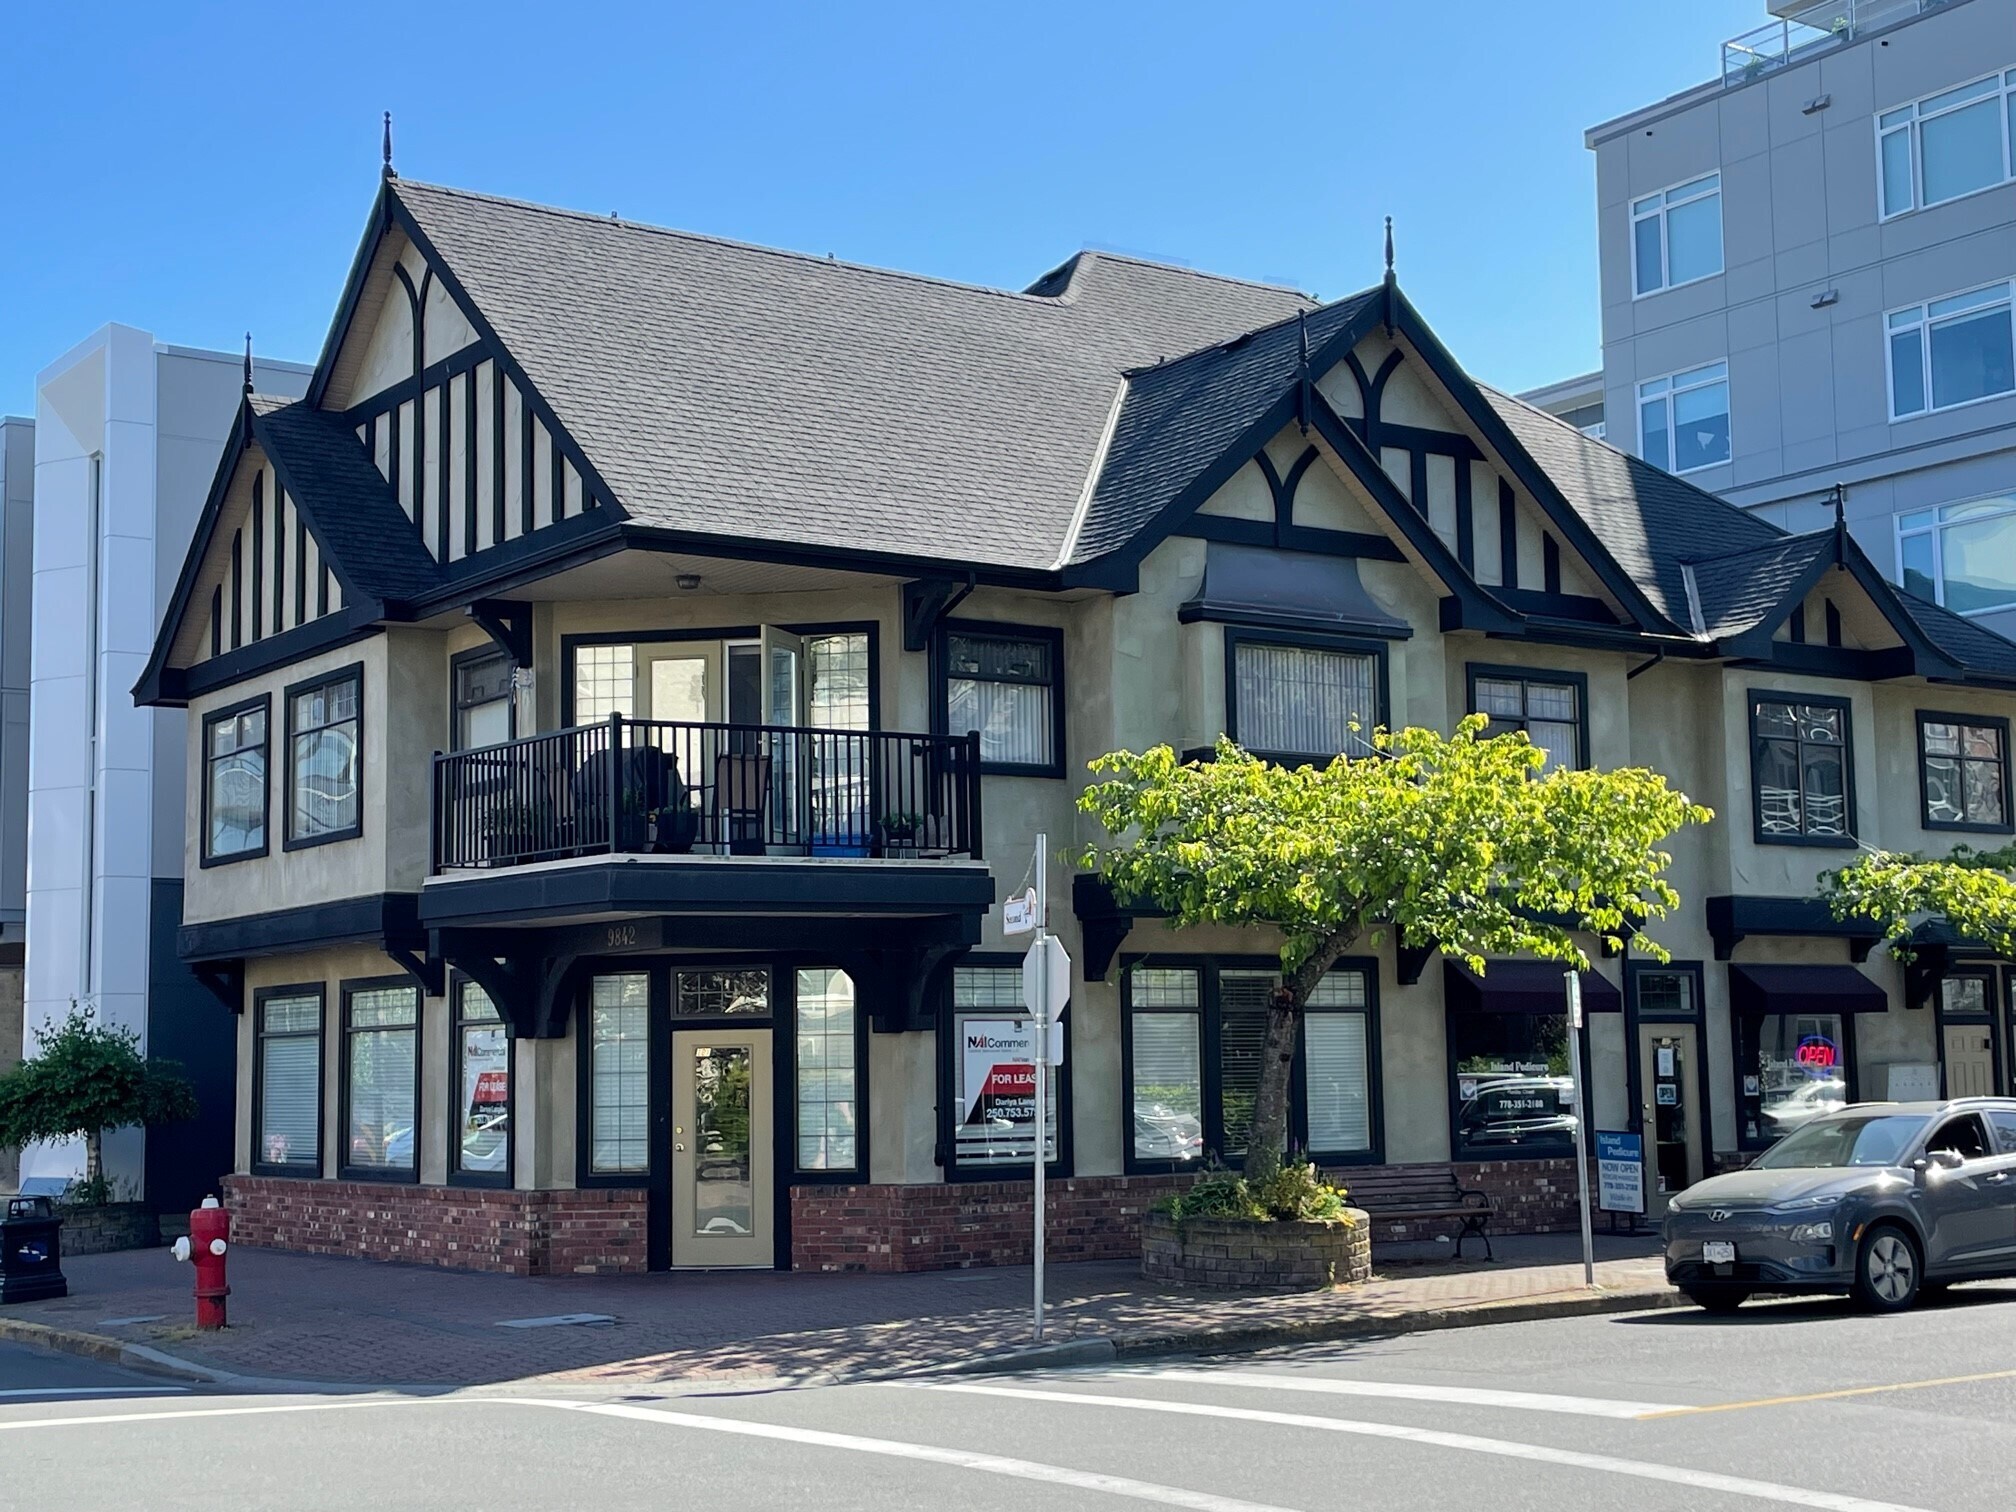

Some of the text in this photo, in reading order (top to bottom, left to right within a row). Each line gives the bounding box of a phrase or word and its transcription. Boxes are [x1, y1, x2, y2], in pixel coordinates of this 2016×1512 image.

[608, 926, 635, 946] 9842
[1799, 1046, 1835, 1067] OPEN
[1490, 1061, 1549, 1072] Island Pedicure
[992, 1073, 1036, 1084] FOR LEAS
[1018, 1097, 1036, 1107] Lang
[986, 1107, 1036, 1119] 250.753.57
[1600, 1136, 1620, 1145] Island
[1608, 1147, 1639, 1157] Pedicure
[1602, 1163, 1639, 1173] NOW OPEN
